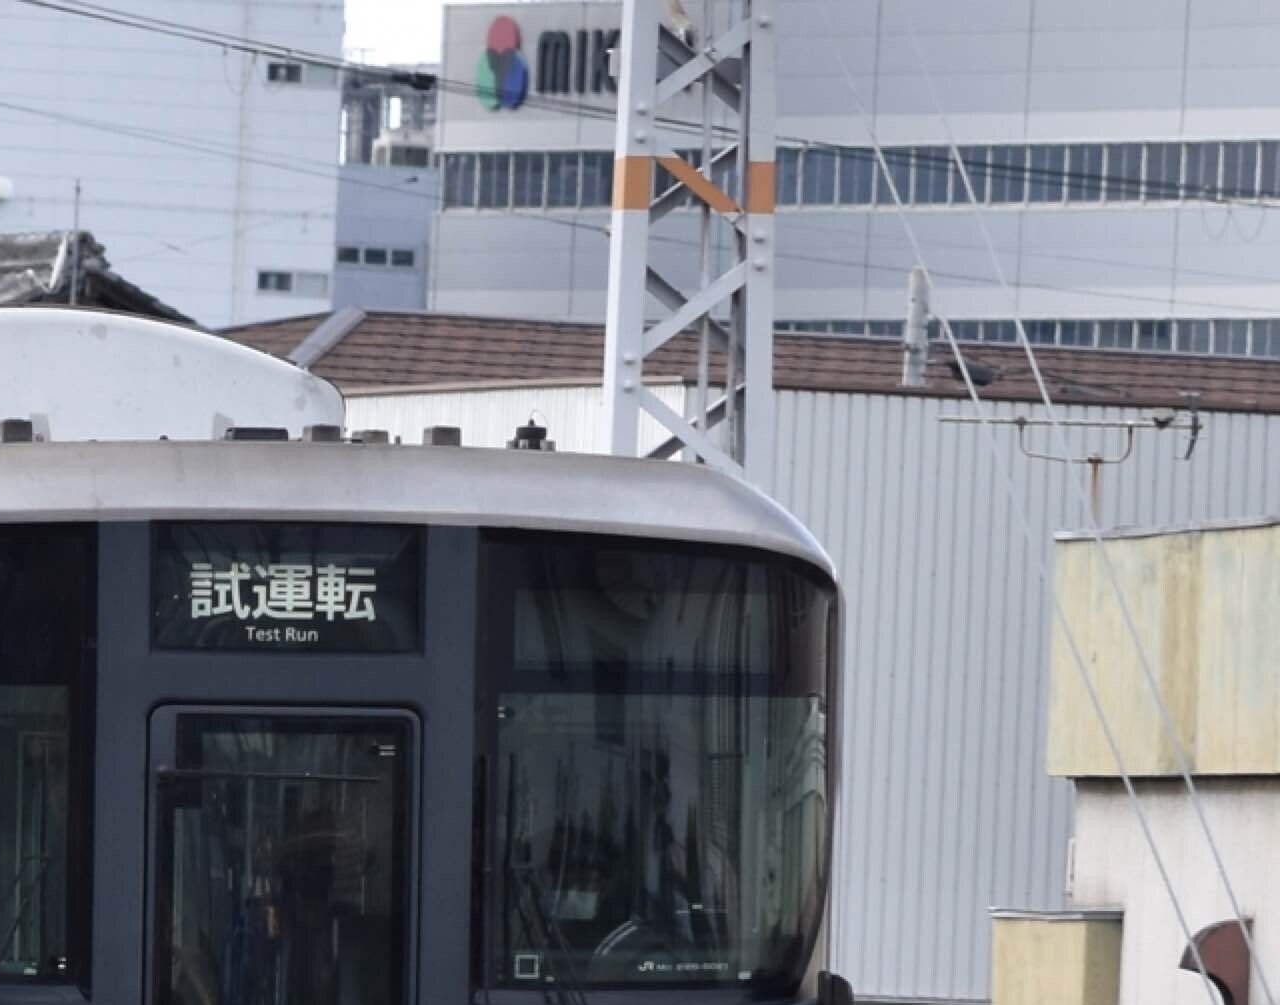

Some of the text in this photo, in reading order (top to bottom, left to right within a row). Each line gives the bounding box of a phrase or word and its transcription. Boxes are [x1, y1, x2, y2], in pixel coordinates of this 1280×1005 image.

[190, 562, 377, 622] 試運転
[246, 626, 319, 642] Test Run
